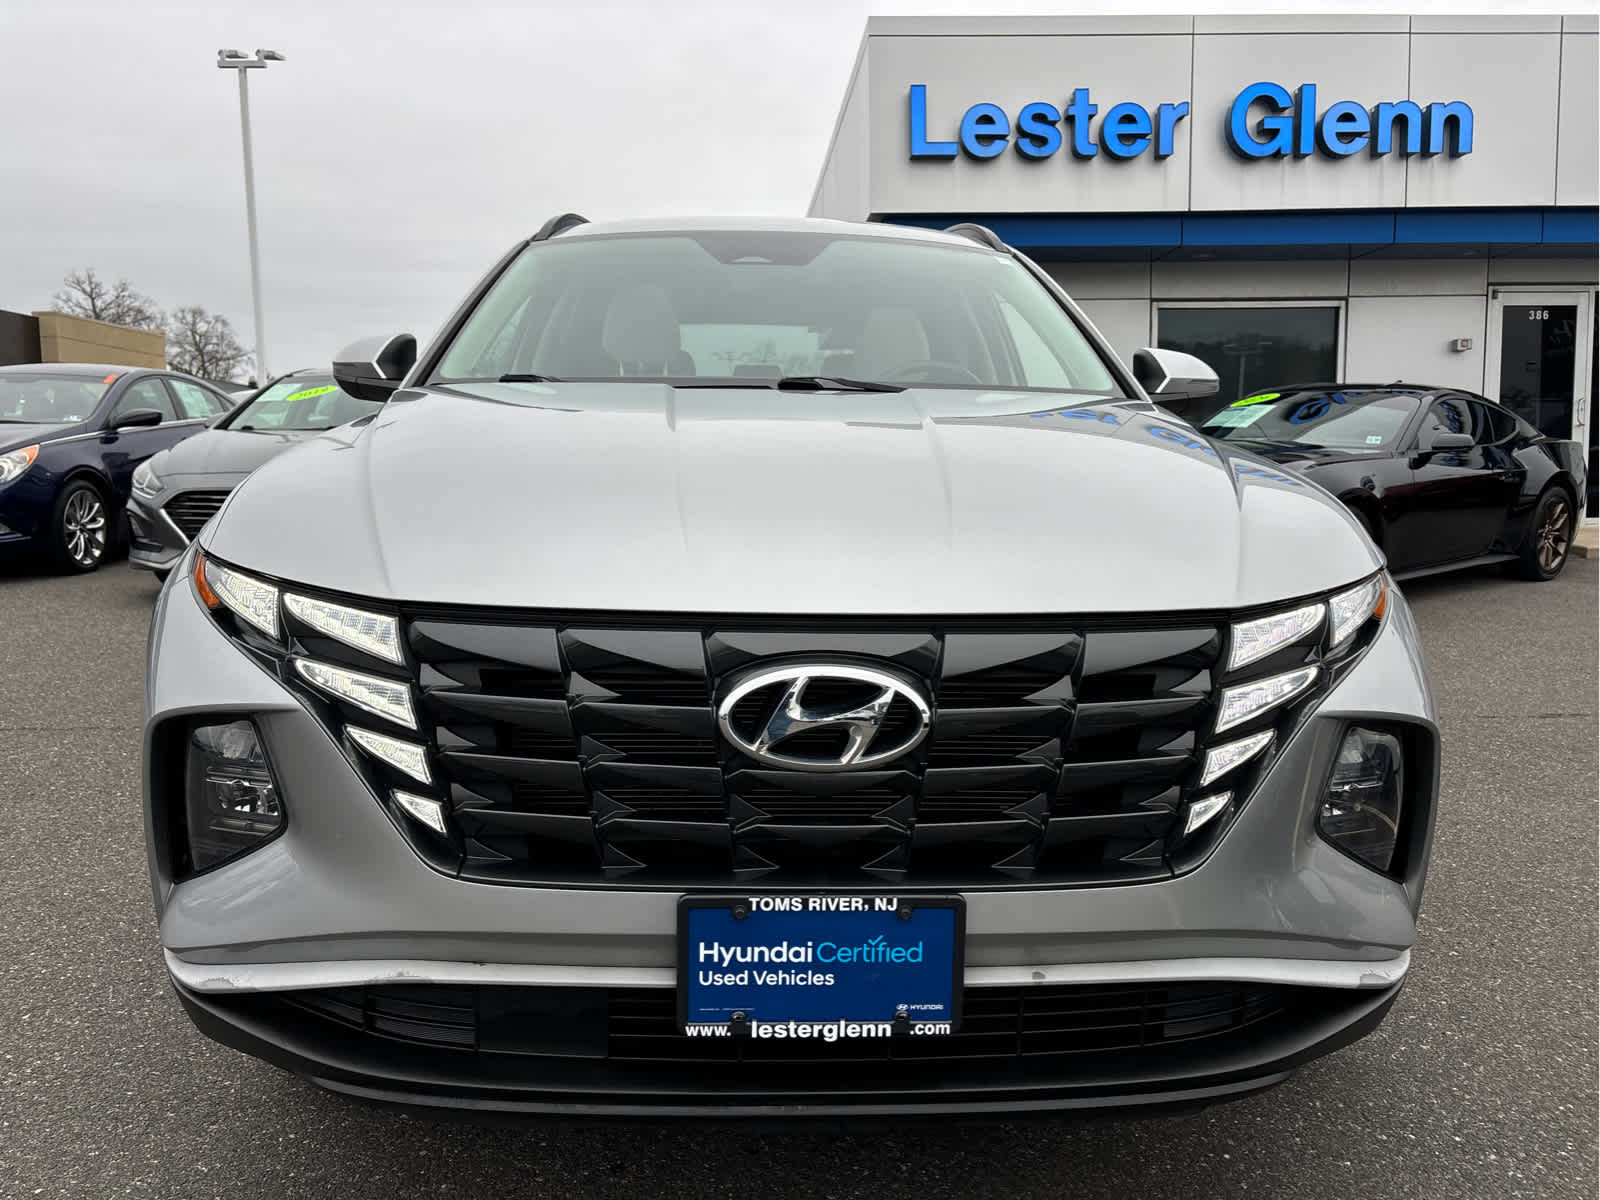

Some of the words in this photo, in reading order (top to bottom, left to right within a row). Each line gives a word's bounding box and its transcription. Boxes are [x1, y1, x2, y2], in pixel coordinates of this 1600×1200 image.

[909, 84, 1189, 160] Lester
[1227, 81, 1474, 158] Glenn
[1528, 310, 1550, 320] 386
[749, 898, 802, 911] TOMS
[808, 898, 869, 912] RIVER,
[875, 898, 898, 911] NJ
[699, 941, 813, 967] Hyundai
[816, 935, 924, 963] Certified
[699, 971, 748, 985] Used
[752, 970, 835, 985] Vehicles
[685, 1026, 732, 1037] www.
[751, 1020, 892, 1042] lesterglenn
[909, 1023, 950, 1036] .com
